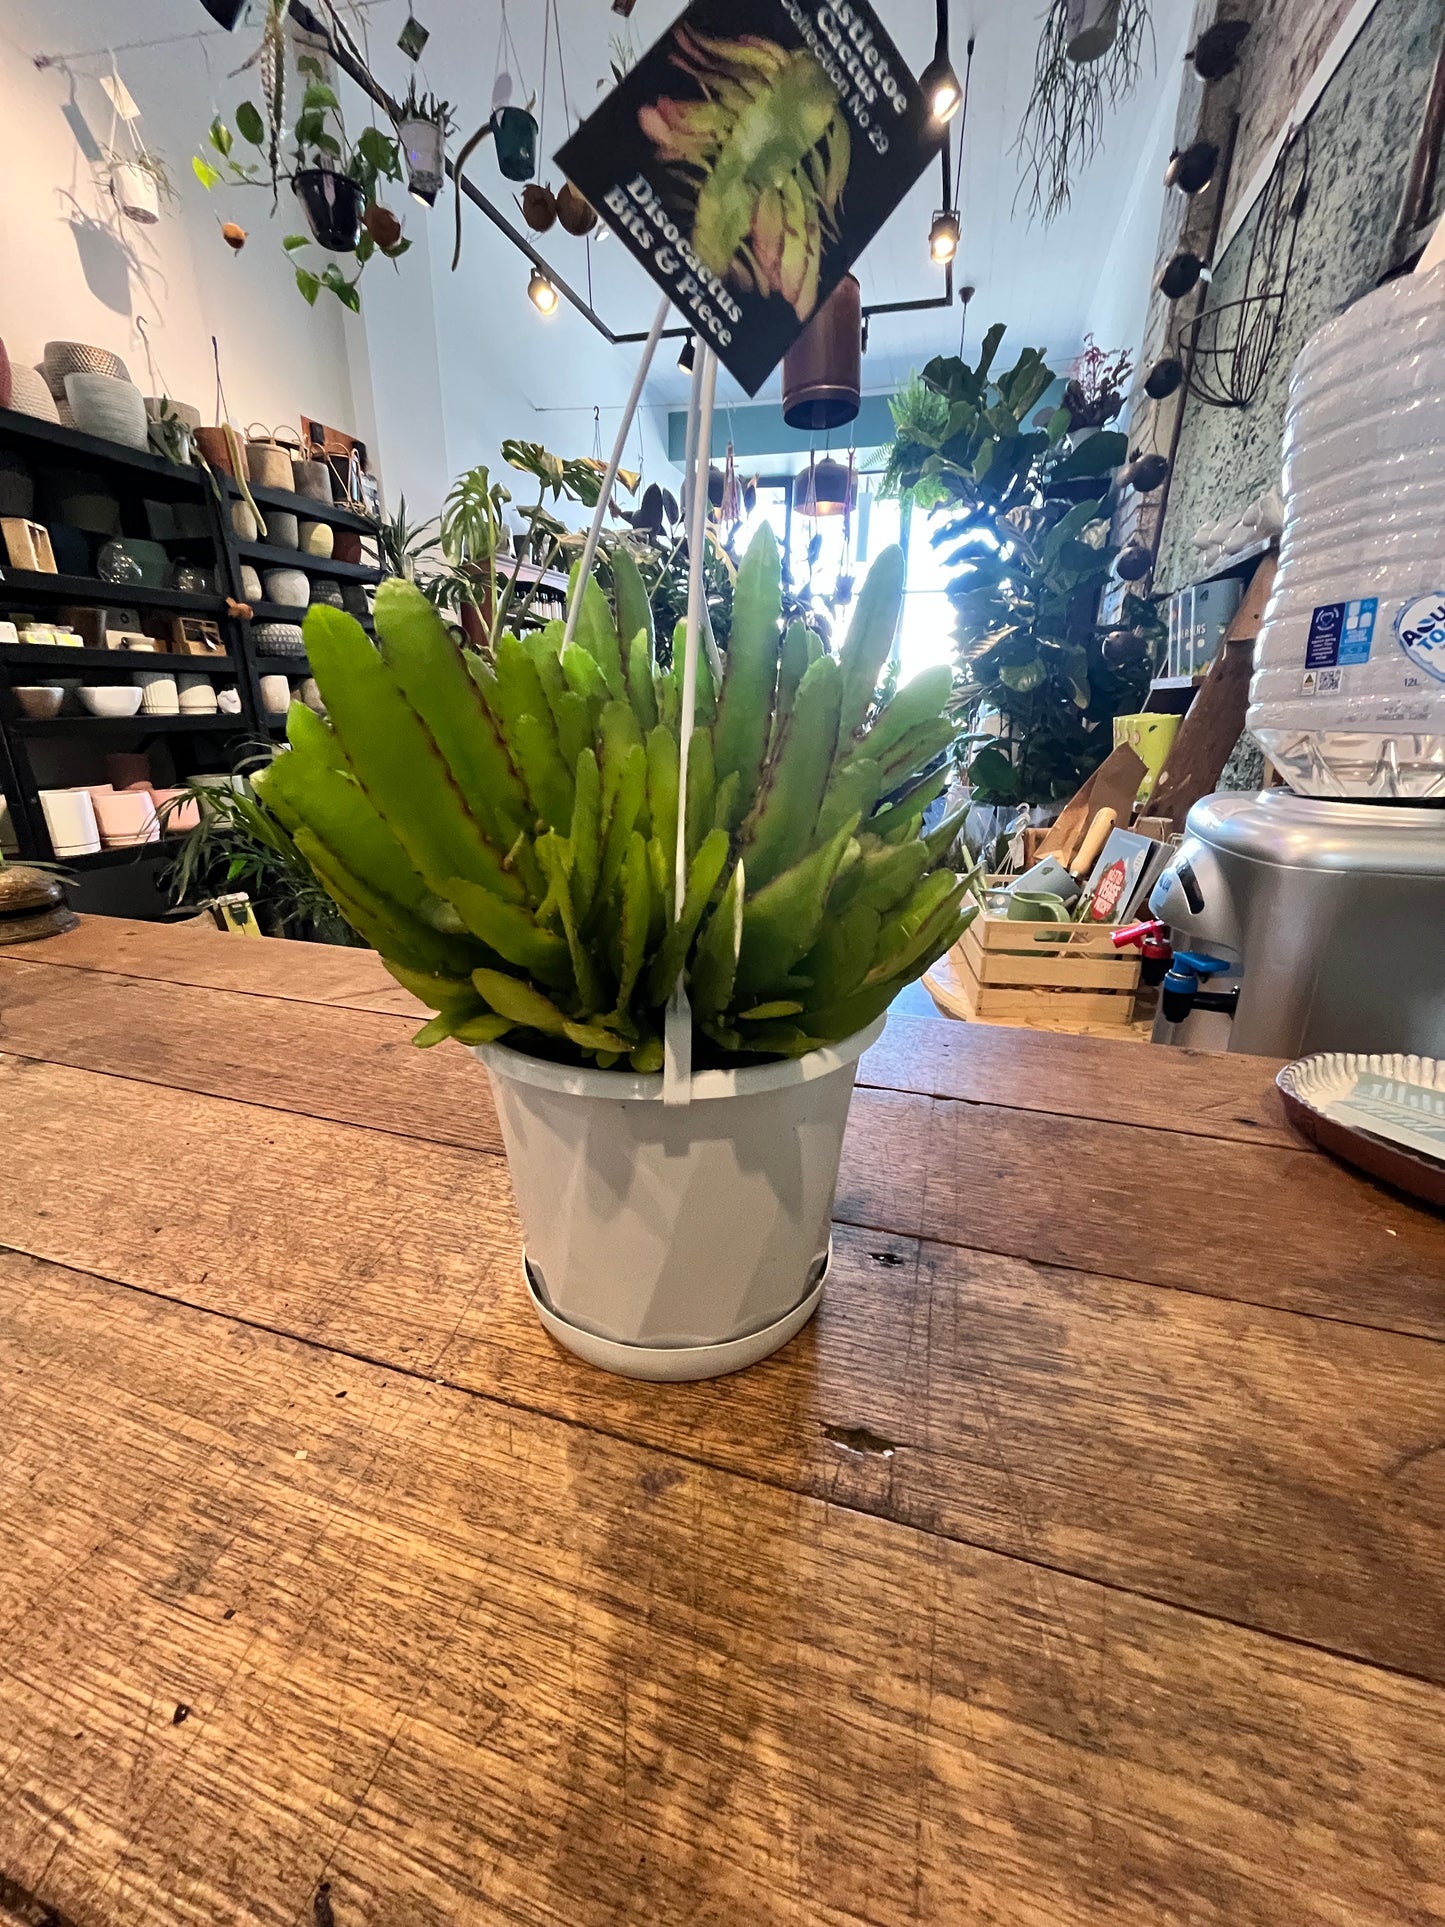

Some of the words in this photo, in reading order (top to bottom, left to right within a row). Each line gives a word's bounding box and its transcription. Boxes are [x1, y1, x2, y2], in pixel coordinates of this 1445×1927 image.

[817, 6, 878, 104] Cactus
[848, 93, 870, 128] No
[868, 124, 889, 155] 29
[603, 183, 654, 250] Bits
[655, 246, 680, 275] &
[676, 271, 732, 347] Piece
[626, 172, 743, 323] Disocactus
[1402, 604, 1445, 647] AQU
